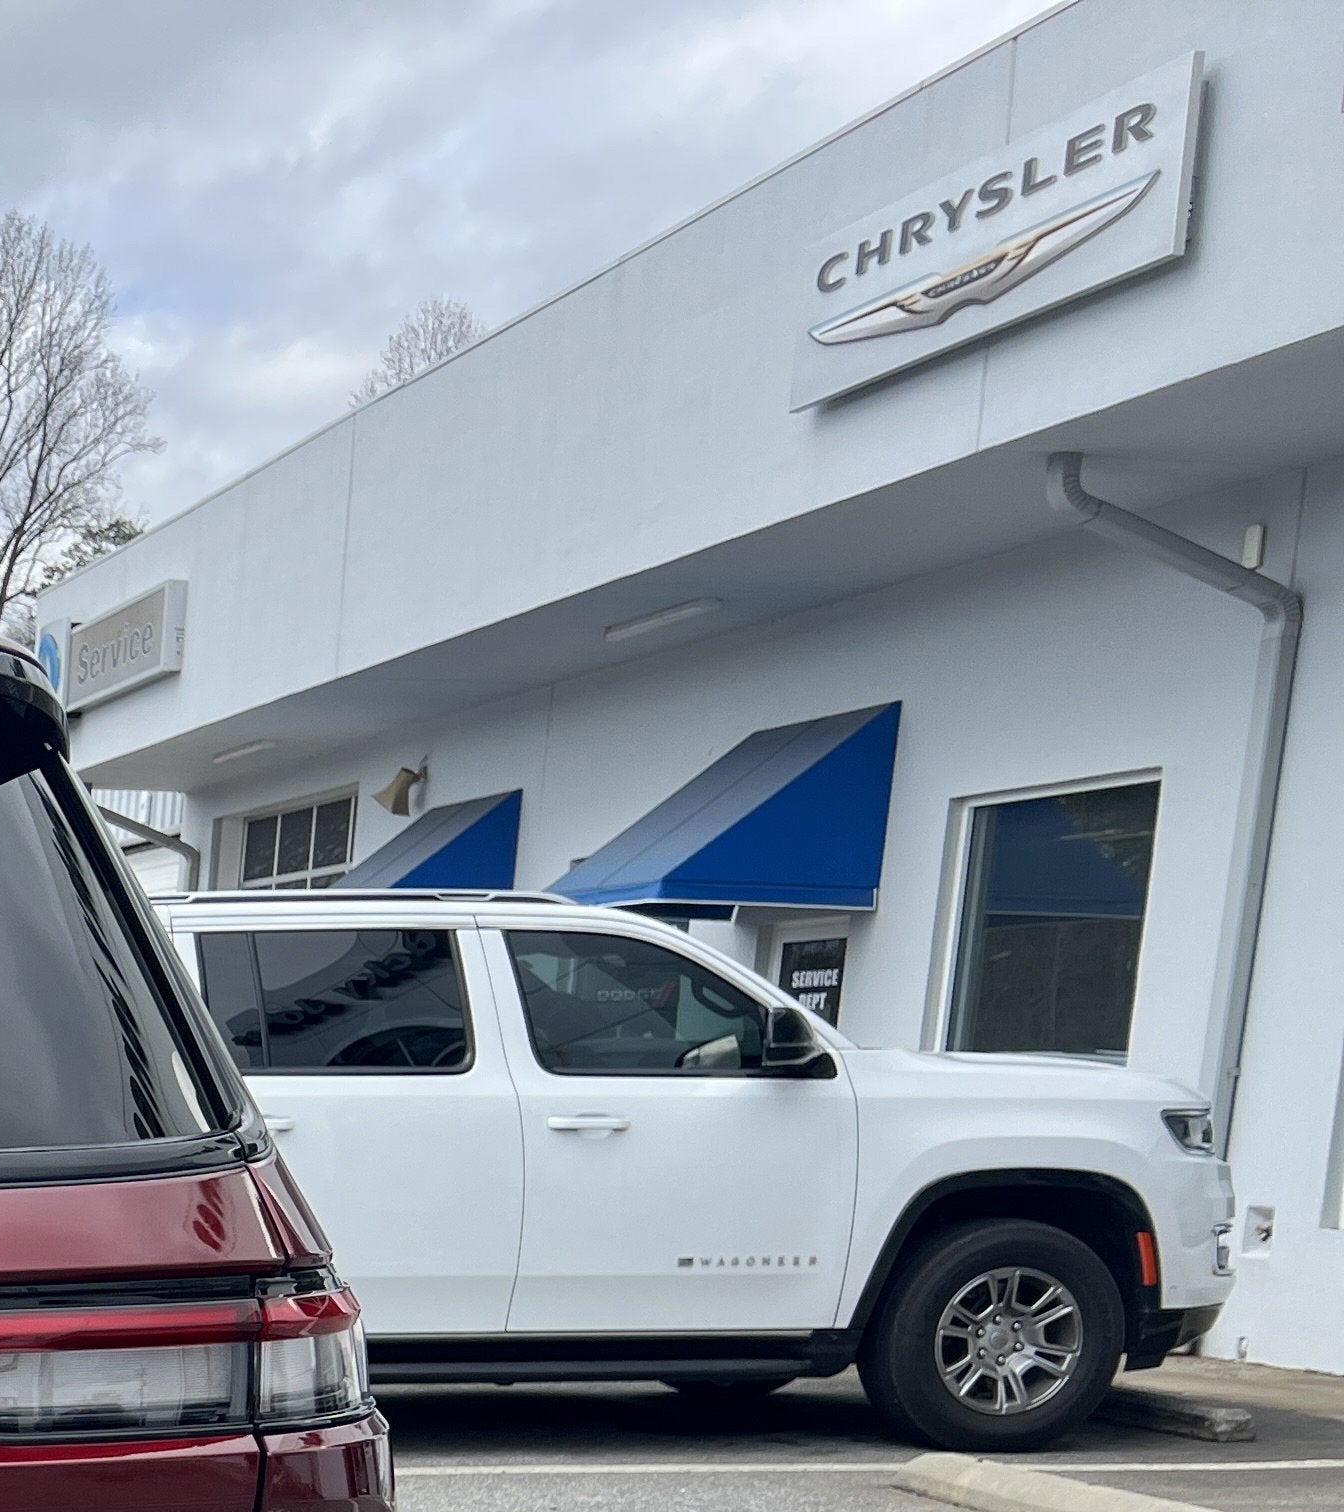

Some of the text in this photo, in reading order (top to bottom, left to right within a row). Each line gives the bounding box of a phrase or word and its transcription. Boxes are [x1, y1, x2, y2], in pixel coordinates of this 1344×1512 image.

[816, 102, 1158, 293] CHRYSLER
[77, 621, 154, 685] Service
[792, 969, 839, 989] SERVICE
[798, 991, 828, 1011] DEPT
[700, 1256, 818, 1267] WAGONEER
